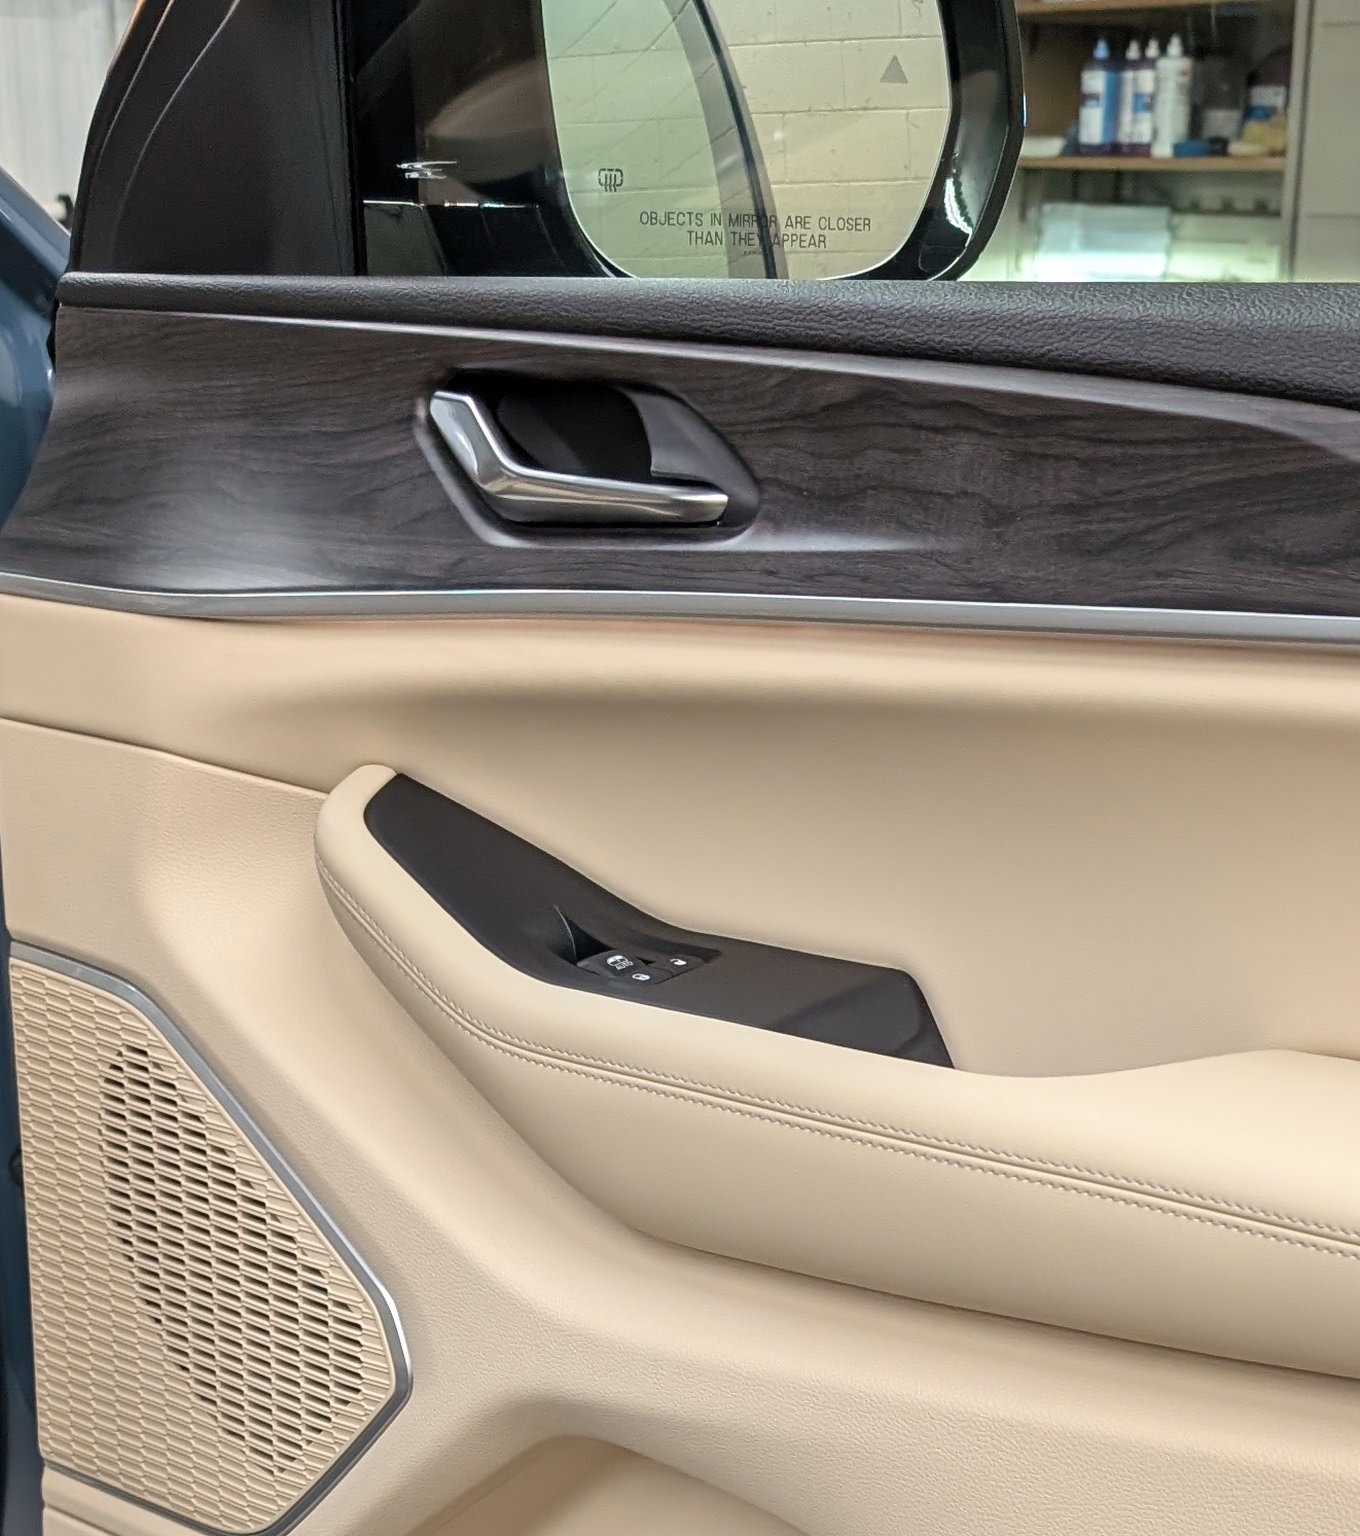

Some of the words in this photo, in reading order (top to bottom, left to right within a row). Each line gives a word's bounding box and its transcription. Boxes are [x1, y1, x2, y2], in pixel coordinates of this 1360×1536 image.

[640, 211, 704, 227] OBJECTS
[710, 212, 722, 227] IN
[785, 215, 811, 230] ARE
[818, 216, 871, 232] CLOSER
[687, 231, 723, 246] THAN
[772, 234, 827, 249] APPEAR
